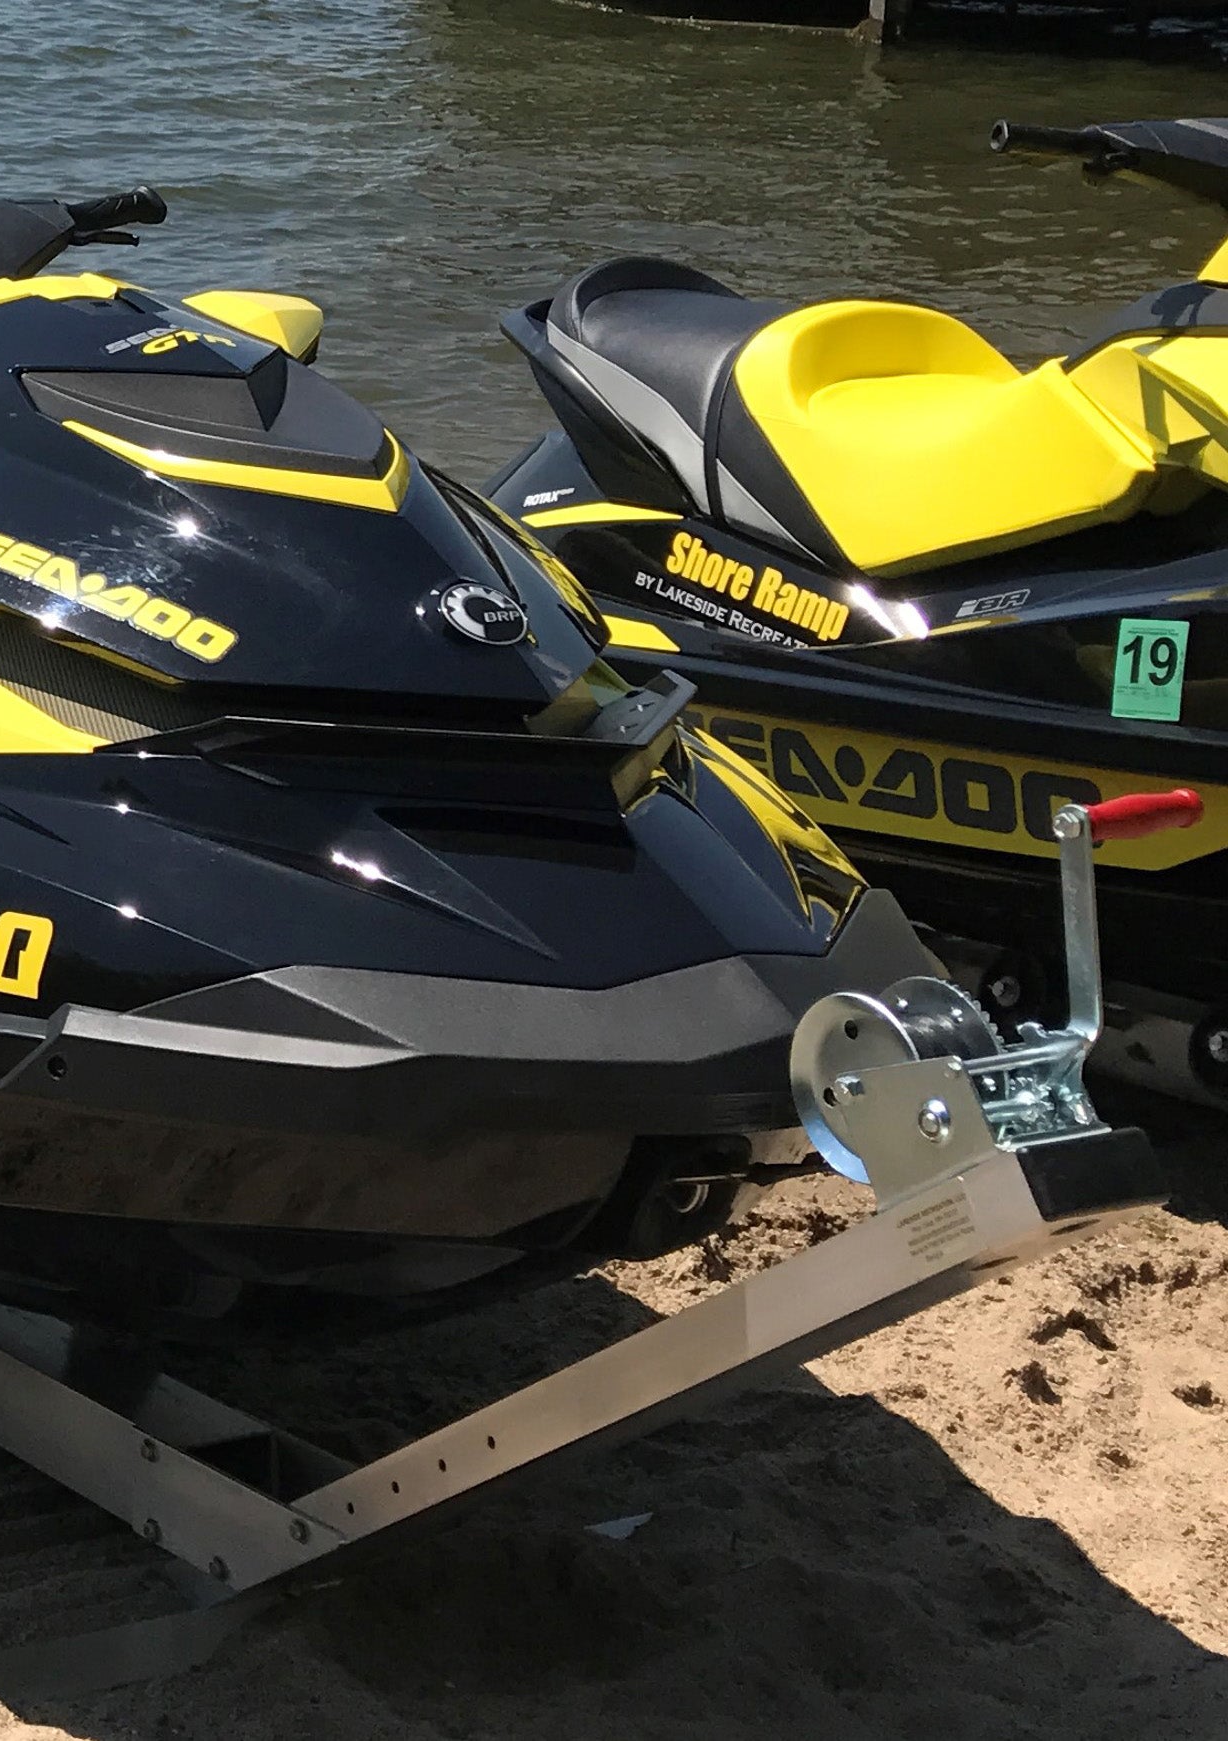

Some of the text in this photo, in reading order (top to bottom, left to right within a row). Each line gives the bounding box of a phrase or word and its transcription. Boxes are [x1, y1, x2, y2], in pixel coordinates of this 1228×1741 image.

[635, 571, 657, 591] BY
[655, 578, 727, 623] LAKESIDE
[667, 532, 850, 642] Shore Ramp
[483, 610, 520, 623] BRP
[1123, 634, 1178, 687] 19
